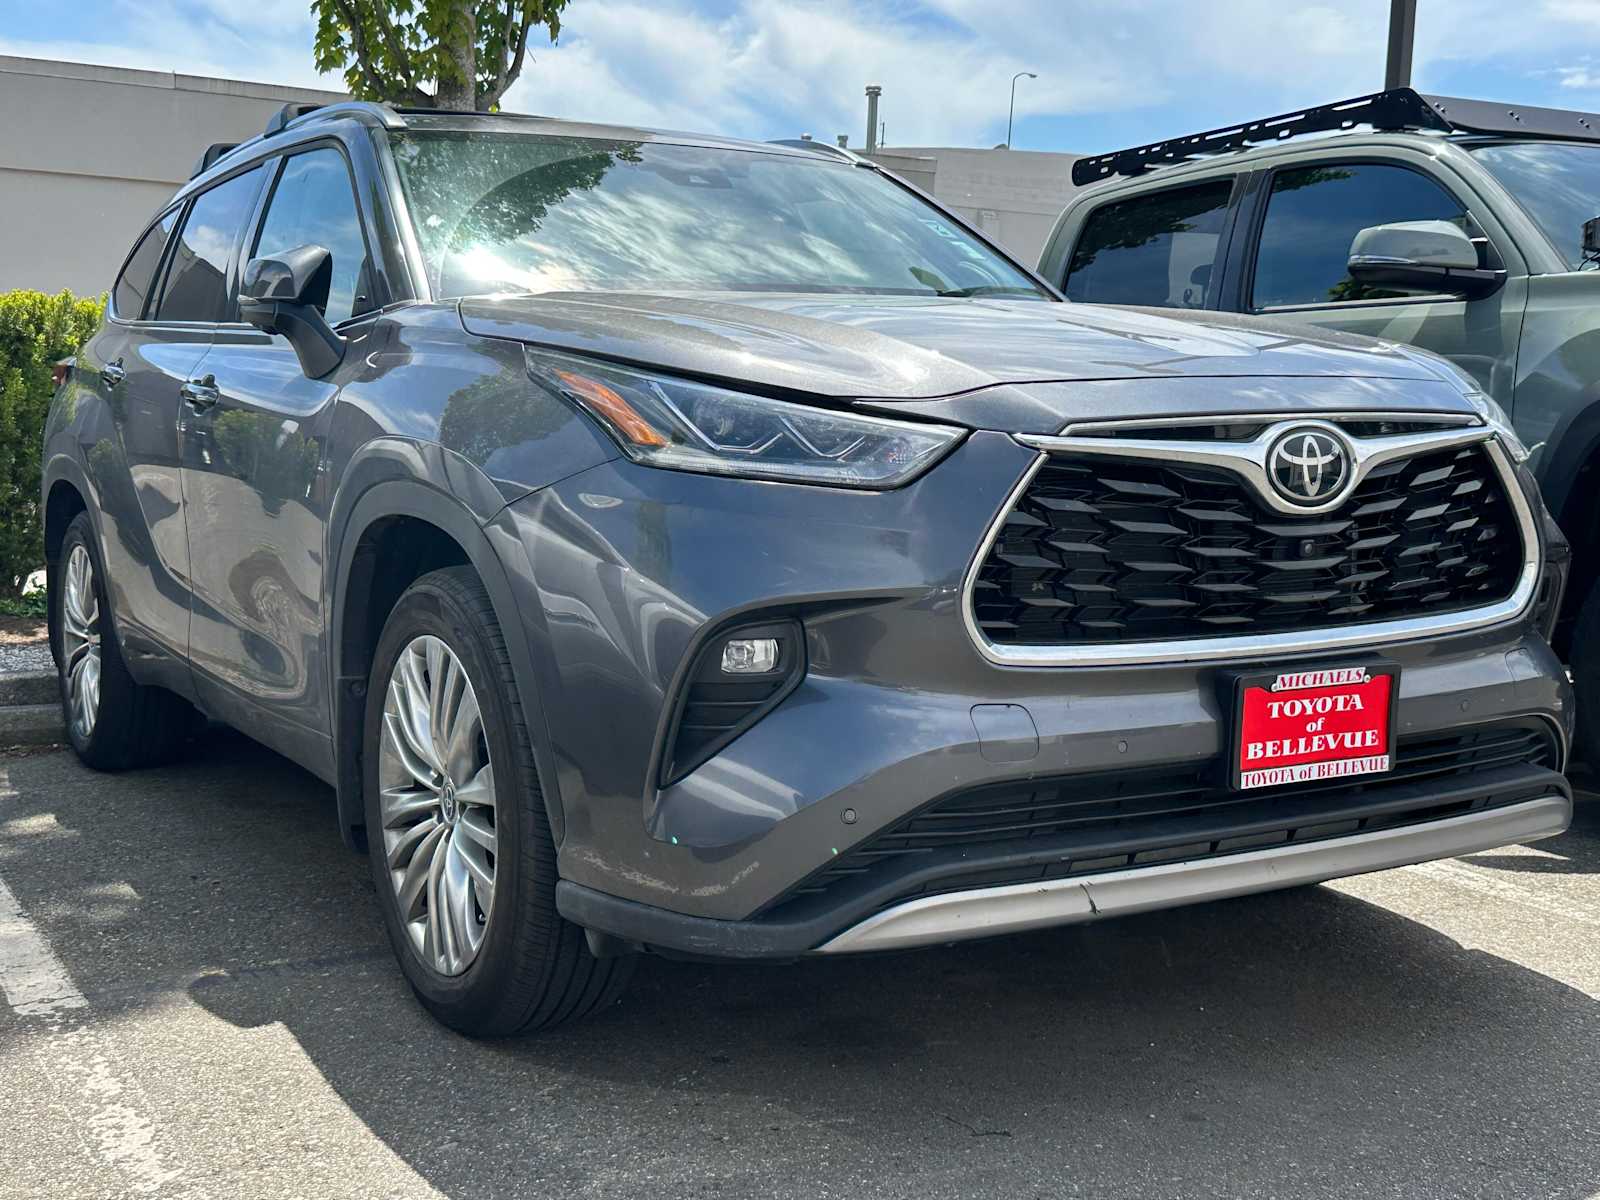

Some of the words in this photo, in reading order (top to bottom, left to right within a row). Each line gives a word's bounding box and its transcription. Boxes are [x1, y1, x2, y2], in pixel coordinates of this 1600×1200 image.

[1278, 668, 1363, 688] MICHAELS
[1267, 694, 1364, 719] TOYOTA
[1306, 717, 1325, 733] of
[1246, 729, 1379, 760] BELLEVUE
[1242, 770, 1295, 788] TOYOTA
[1300, 766, 1314, 780] of
[1317, 757, 1388, 778] BELLEVUE
